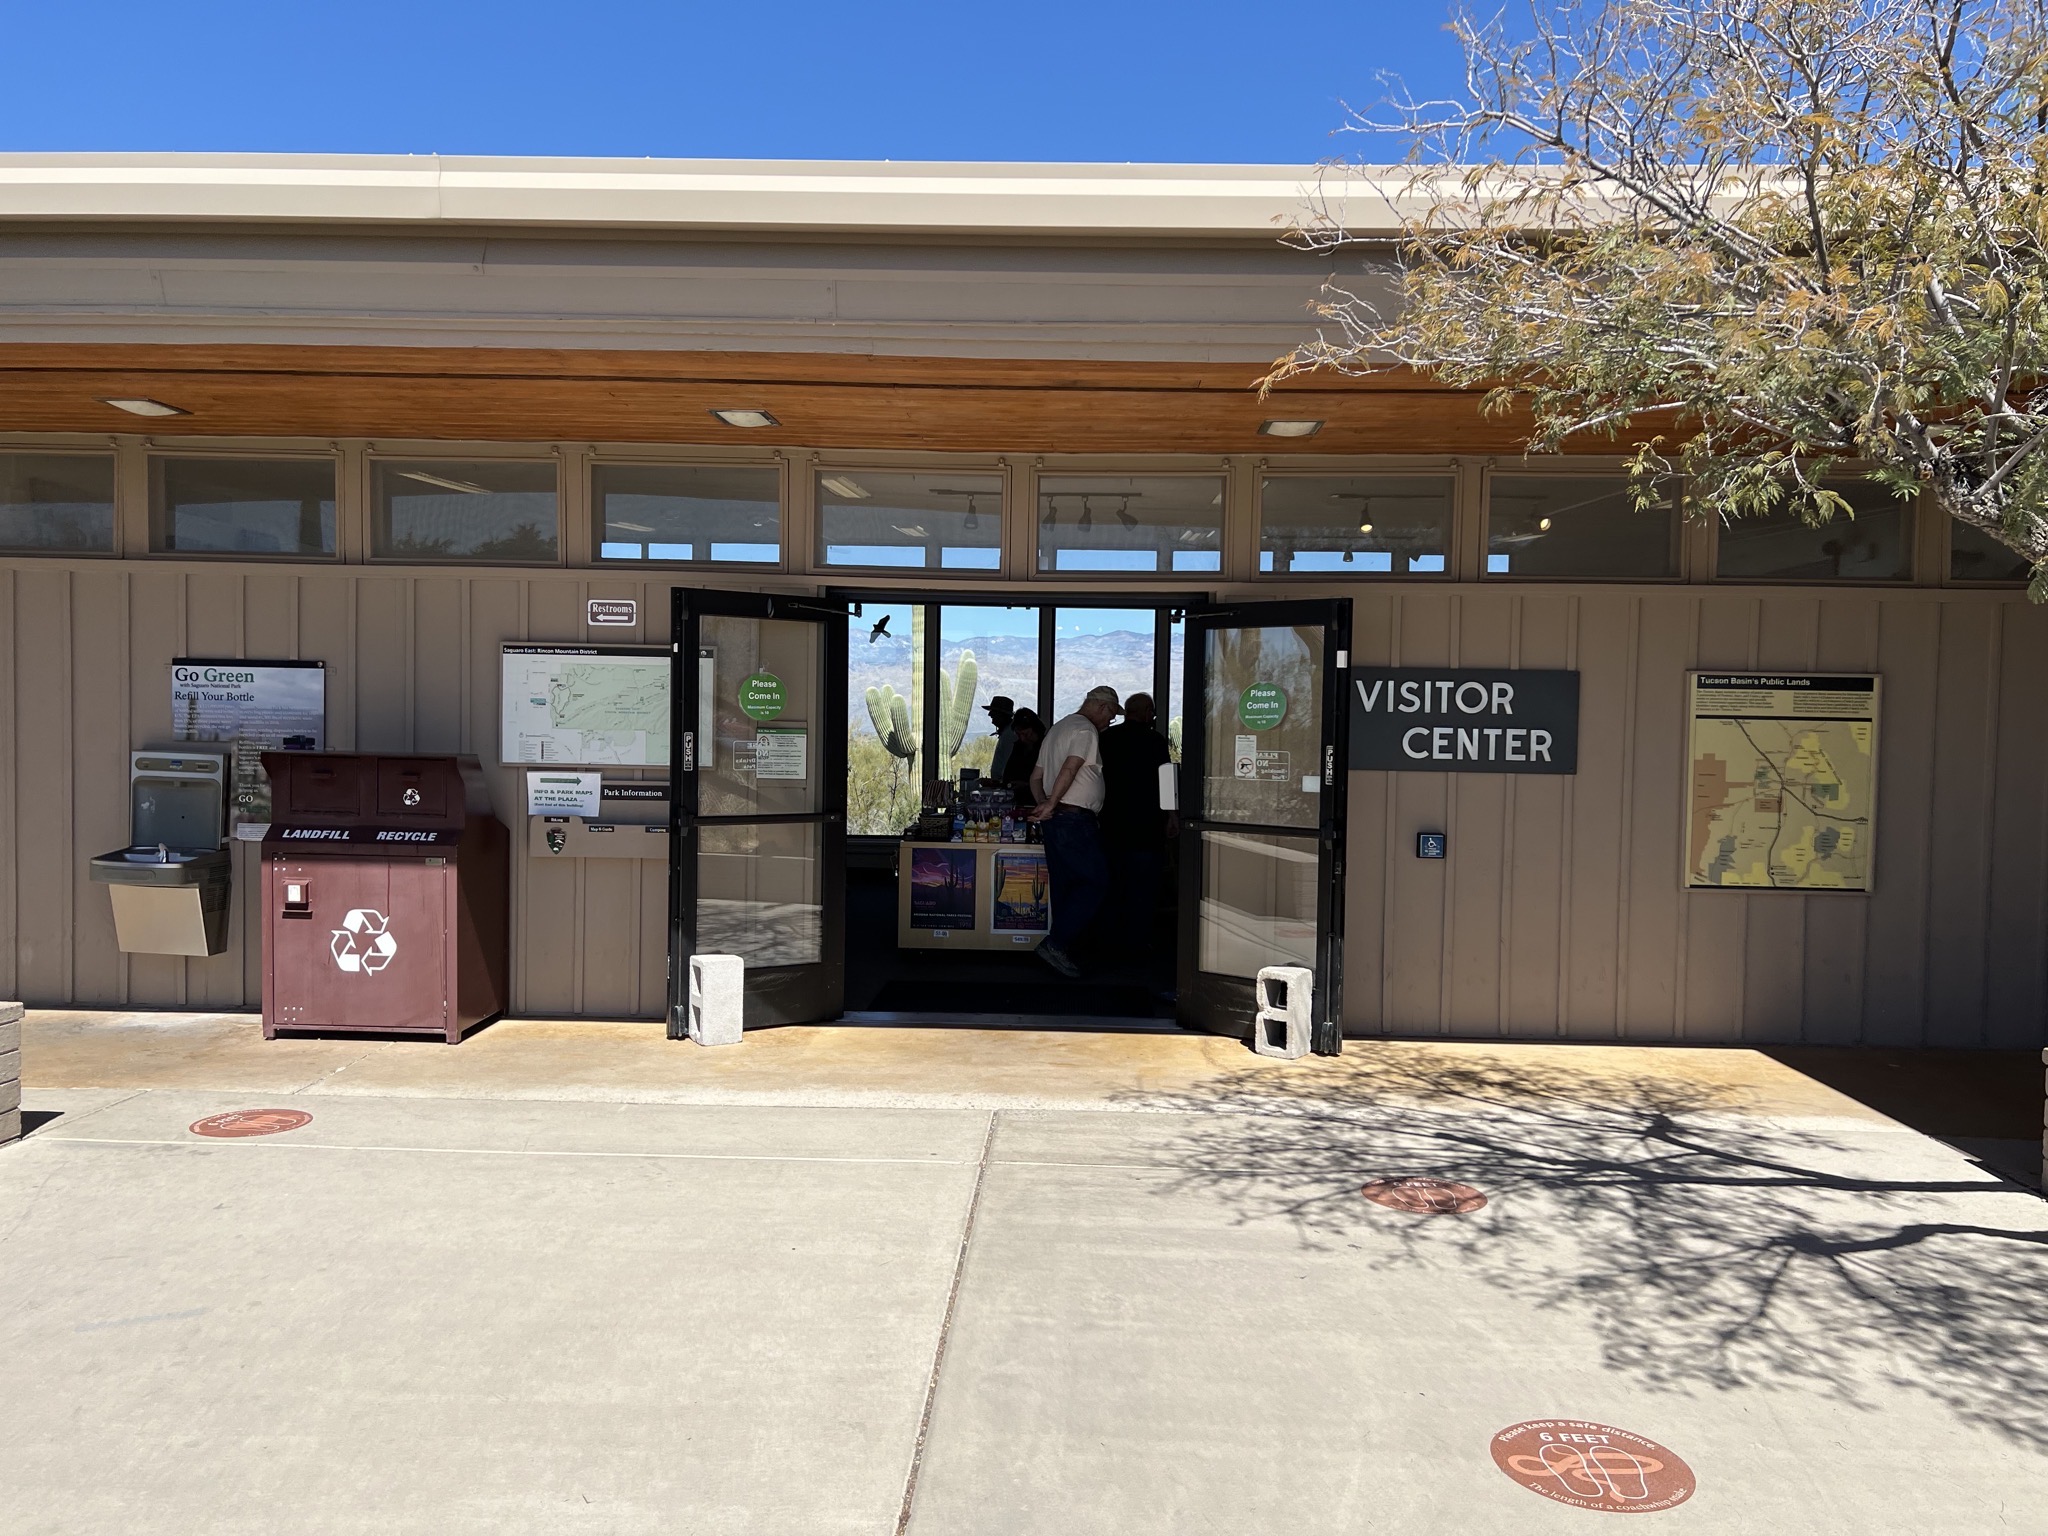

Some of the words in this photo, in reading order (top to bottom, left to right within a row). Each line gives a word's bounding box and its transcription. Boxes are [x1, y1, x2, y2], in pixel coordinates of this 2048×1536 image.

[592, 603, 632, 613] Restrooms
[175, 667, 199, 682] Go
[204, 668, 254, 682] Green
[752, 680, 776, 688] Please
[1700, 677, 1729, 685] Tucson
[1731, 677, 1759, 685] Basin's
[1761, 678, 1785, 686] Public
[175, 691, 198, 700] Refill
[201, 692, 224, 701] Your
[226, 692, 254, 701] Bottle
[748, 692, 771, 700] Come
[773, 692, 780, 700] In
[1356, 680, 1514, 715] VISITOR
[1402, 726, 1553, 762] CENTER
[621, 789, 662, 797] Information
[282, 829, 350, 840] LANDFILL
[376, 831, 437, 841] RECYCLE
[1498, 1426, 1526, 1442] Please
[1523, 1421, 1555, 1431] keep
[1569, 1422, 1598, 1430] safe
[1601, 1425, 1656, 1450] distance.
[1539, 1432, 1553, 1442] 6
[1559, 1433, 1610, 1445] FEET
[1528, 1482, 1547, 1494] The
[1550, 1490, 1587, 1506] length
[1616, 1499, 1671, 1511] coachwhip
